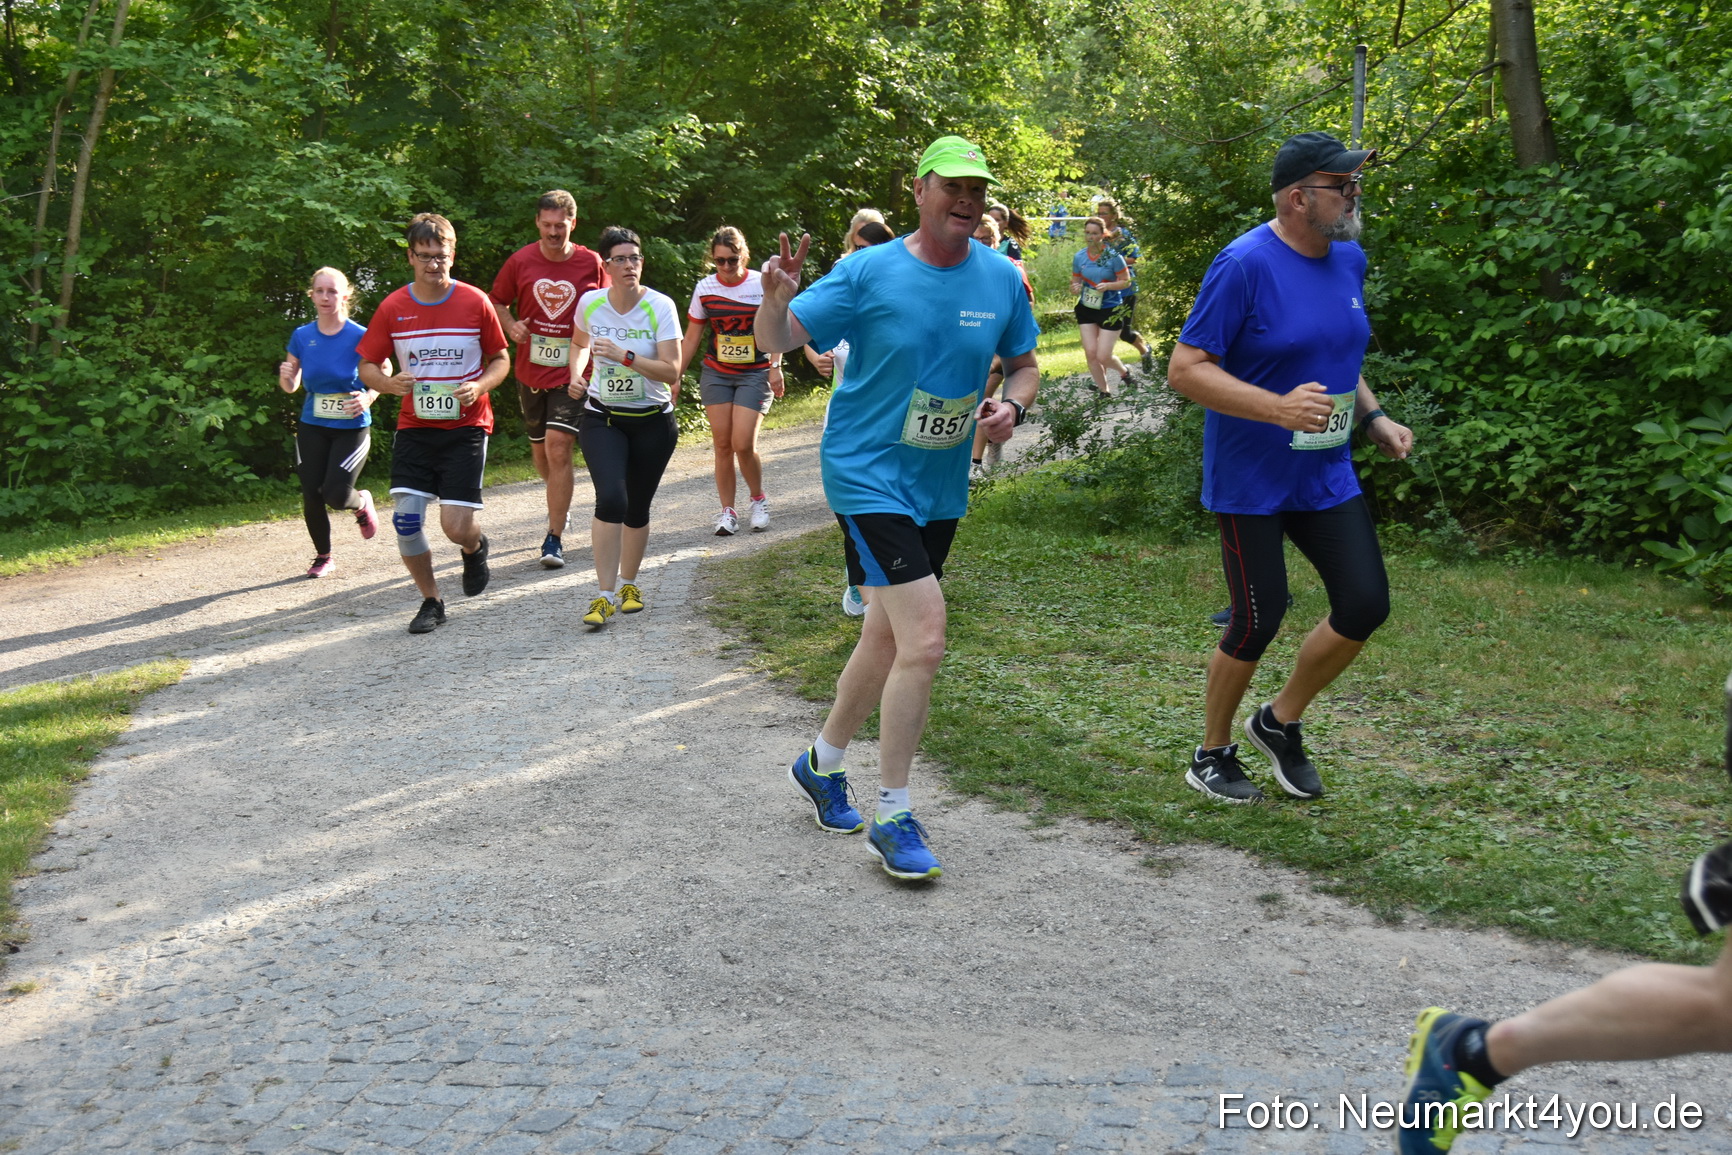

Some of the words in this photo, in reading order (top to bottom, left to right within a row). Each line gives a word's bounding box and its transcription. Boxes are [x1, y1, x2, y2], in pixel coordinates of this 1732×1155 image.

[966, 311, 996, 320] PFLEIDERER
[959, 320, 981, 328] Rudolf
[591, 325, 652, 341] gangart
[538, 346, 560, 359] 700
[721, 345, 749, 356] 2254
[607, 379, 634, 392] 922
[321, 399, 344, 411] 575
[418, 396, 453, 409] 1810
[917, 413, 970, 436] 1857
